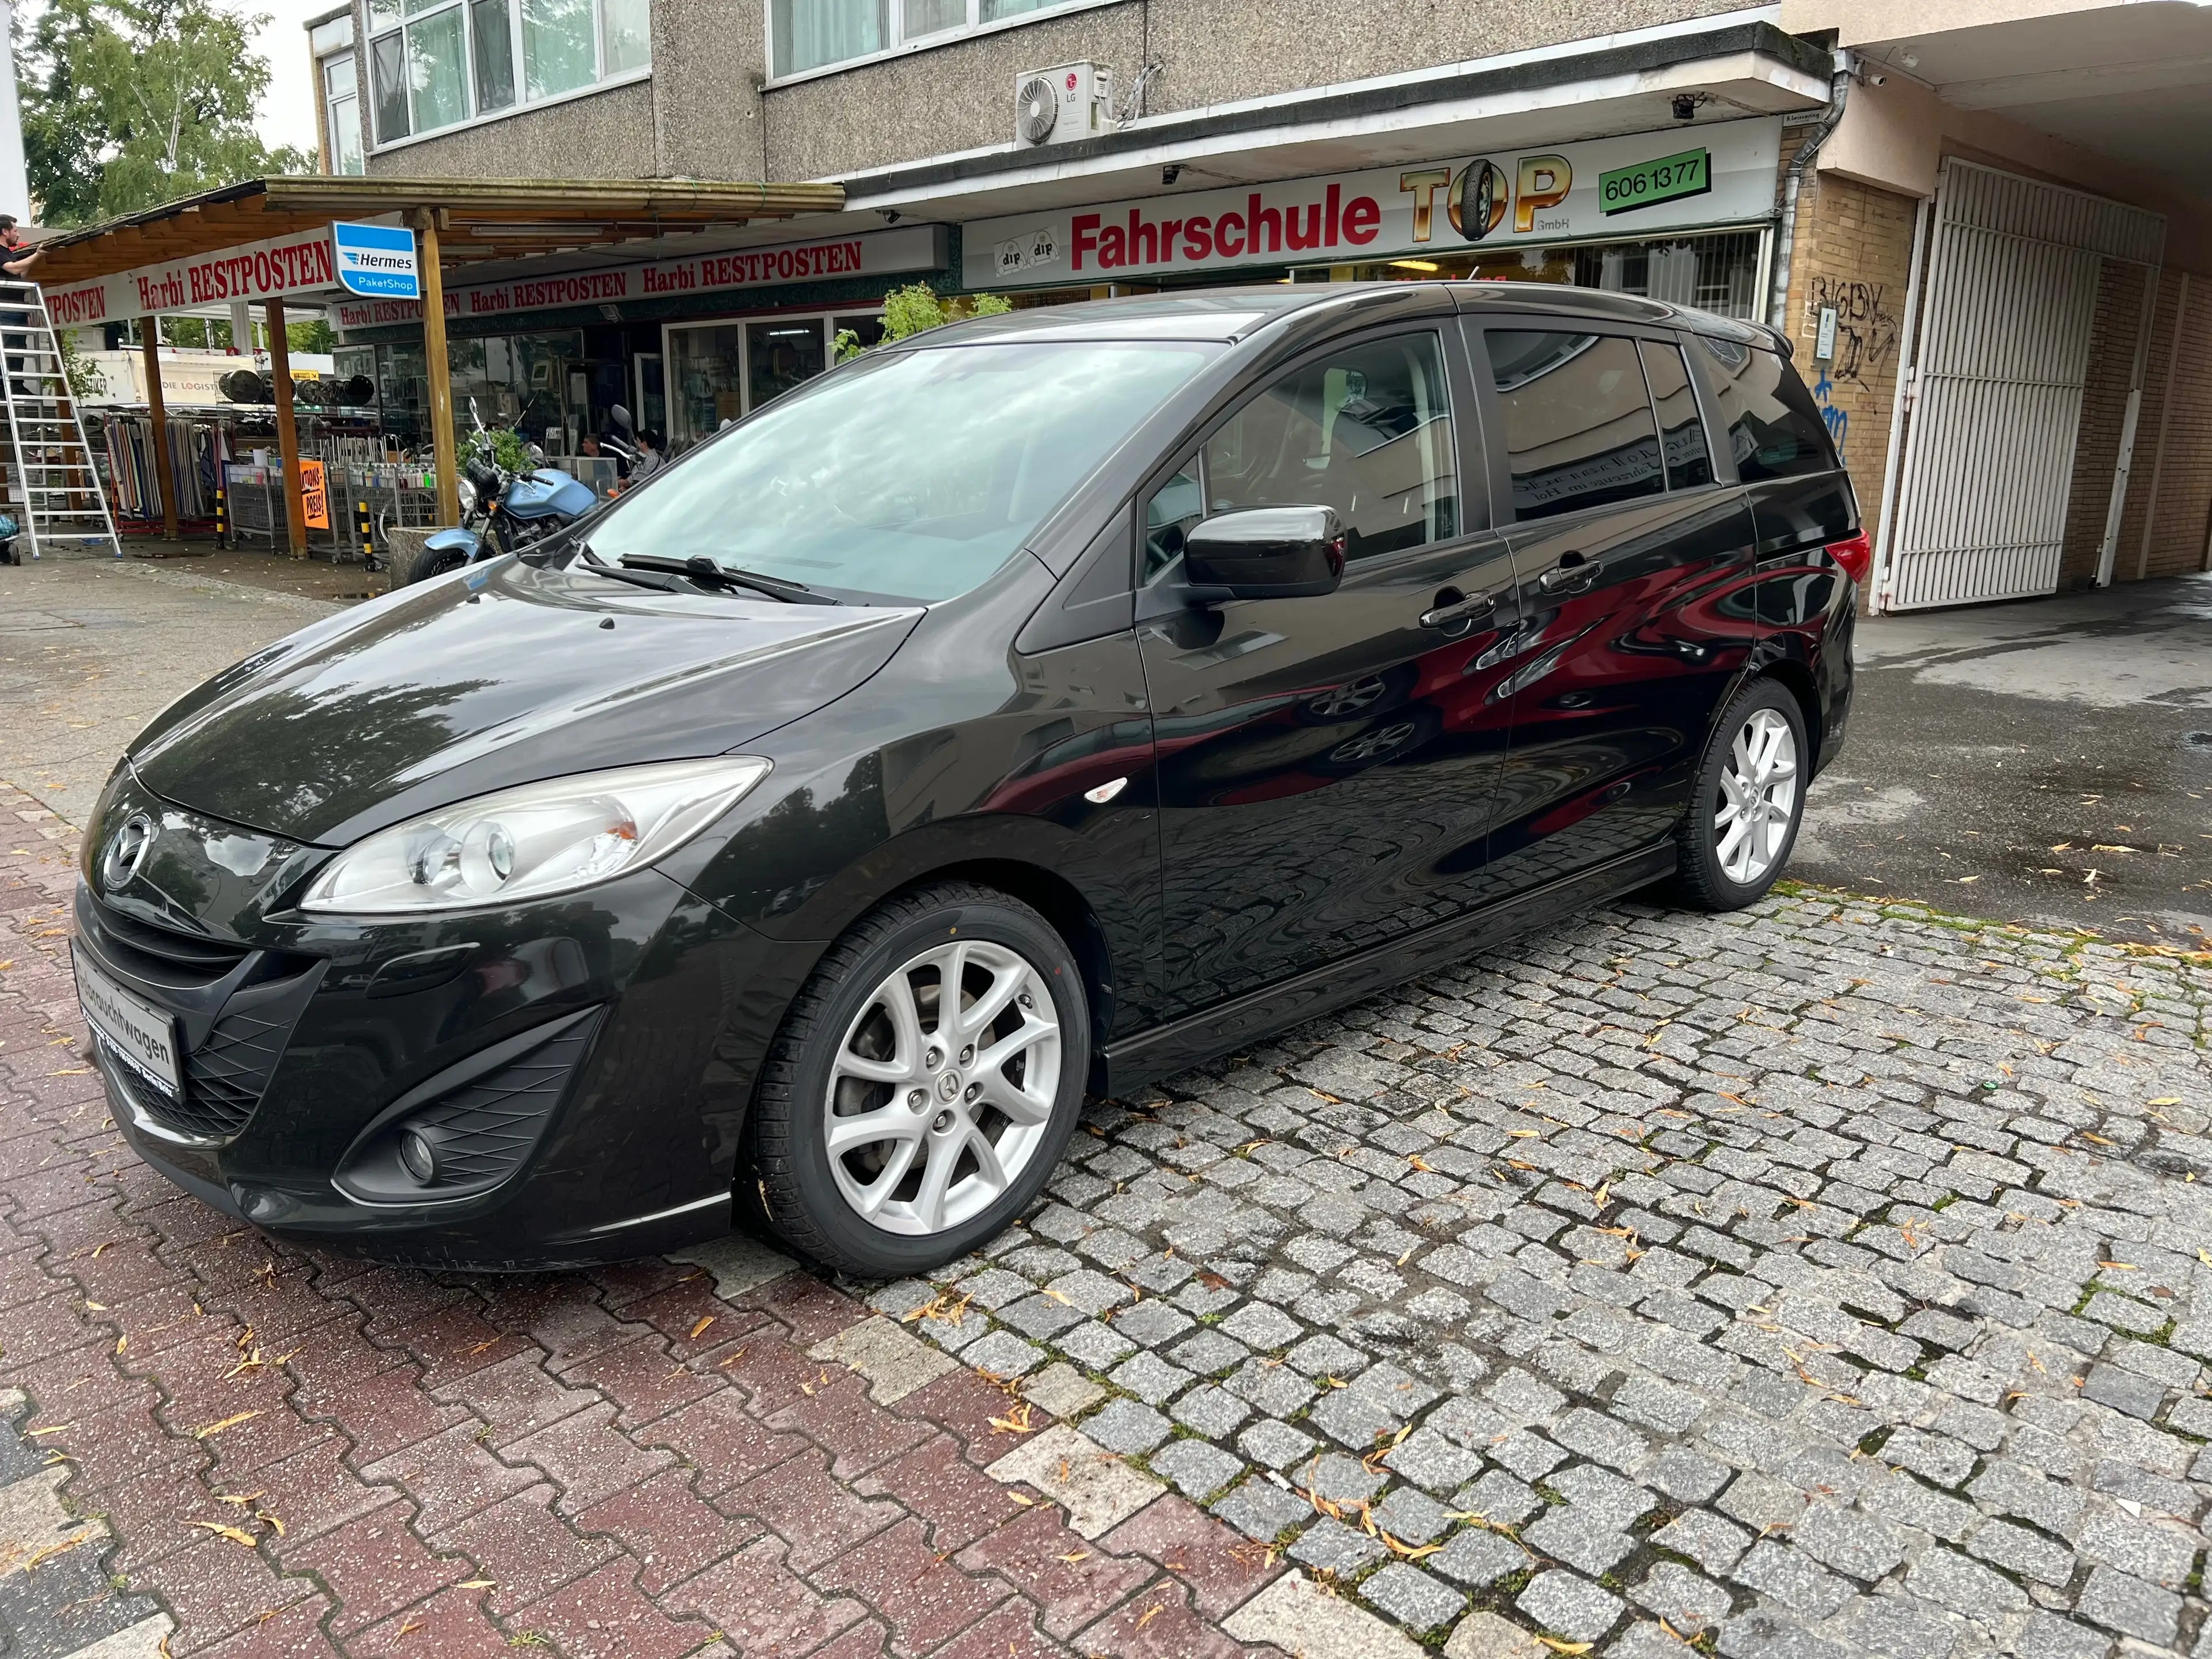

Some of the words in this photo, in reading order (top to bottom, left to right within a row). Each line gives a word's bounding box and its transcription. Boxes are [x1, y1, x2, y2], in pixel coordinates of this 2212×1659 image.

[1067, 93, 1075, 103] LG
[1071, 183, 1380, 271] Fahrschule
[1400, 154, 1573, 243] TOP
[1537, 218, 1569, 231] GmbH
[360, 253, 412, 269] Hermes
[1003, 252, 1020, 266] dip
[1035, 243, 1052, 256] dip
[137, 269, 185, 311] Harbi
[188, 240, 334, 304] RESTPOSTEN
[642, 263, 696, 293] Harbi
[701, 241, 862, 286] RESTPOSTEN
[359, 276, 413, 291] PaketShop
[470, 286, 510, 313] Harbi
[513, 272, 626, 308] RESTPOSTEN
[45, 286, 105, 324] TPOSTEN
[340, 301, 372, 325] Harbi
[373, 293, 460, 323] RESTPOEN
[181, 382, 218, 392] LOGISTI
[306, 490, 324, 516] PREIS!
